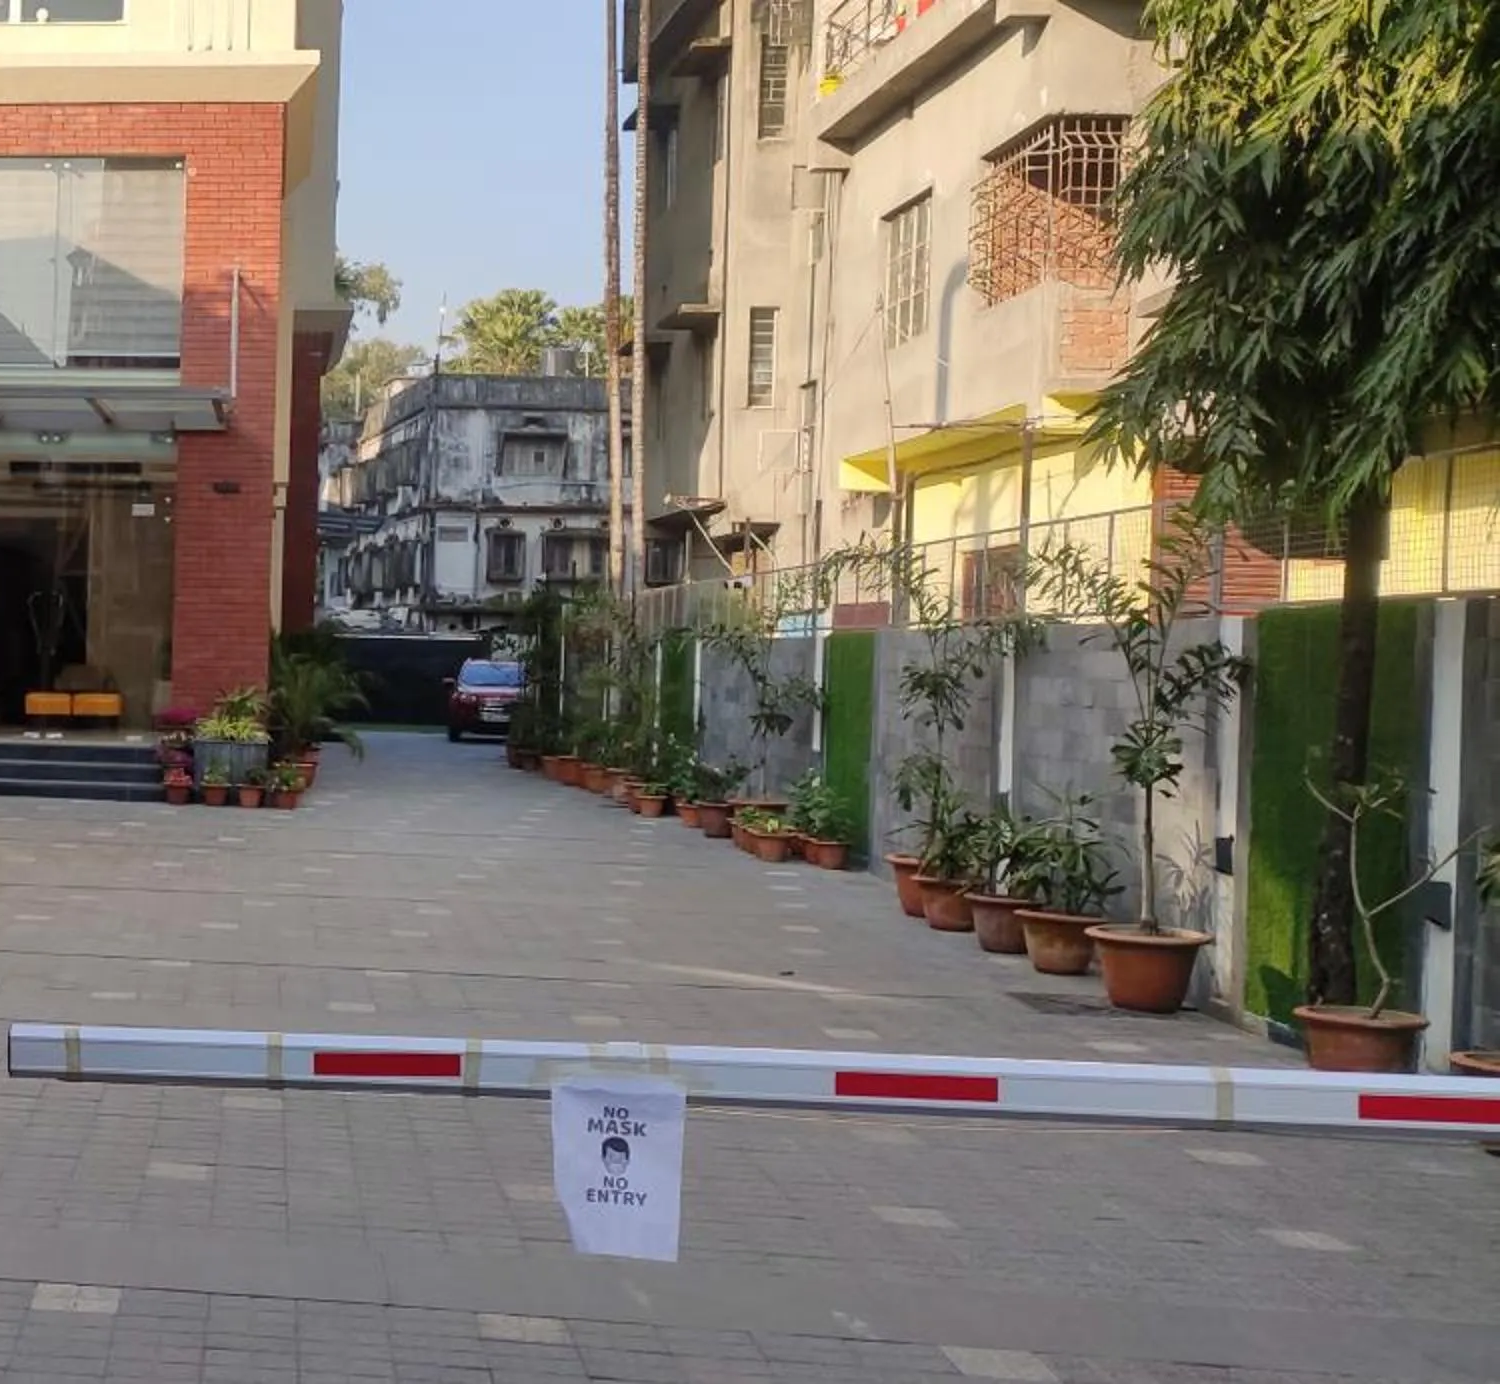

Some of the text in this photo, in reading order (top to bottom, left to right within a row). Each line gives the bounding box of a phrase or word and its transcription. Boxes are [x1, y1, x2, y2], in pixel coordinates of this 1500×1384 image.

[603, 1106, 630, 1120] NO
[587, 1118, 647, 1137] MASK
[603, 1176, 629, 1190] NO
[586, 1188, 648, 1206] ENTRY
